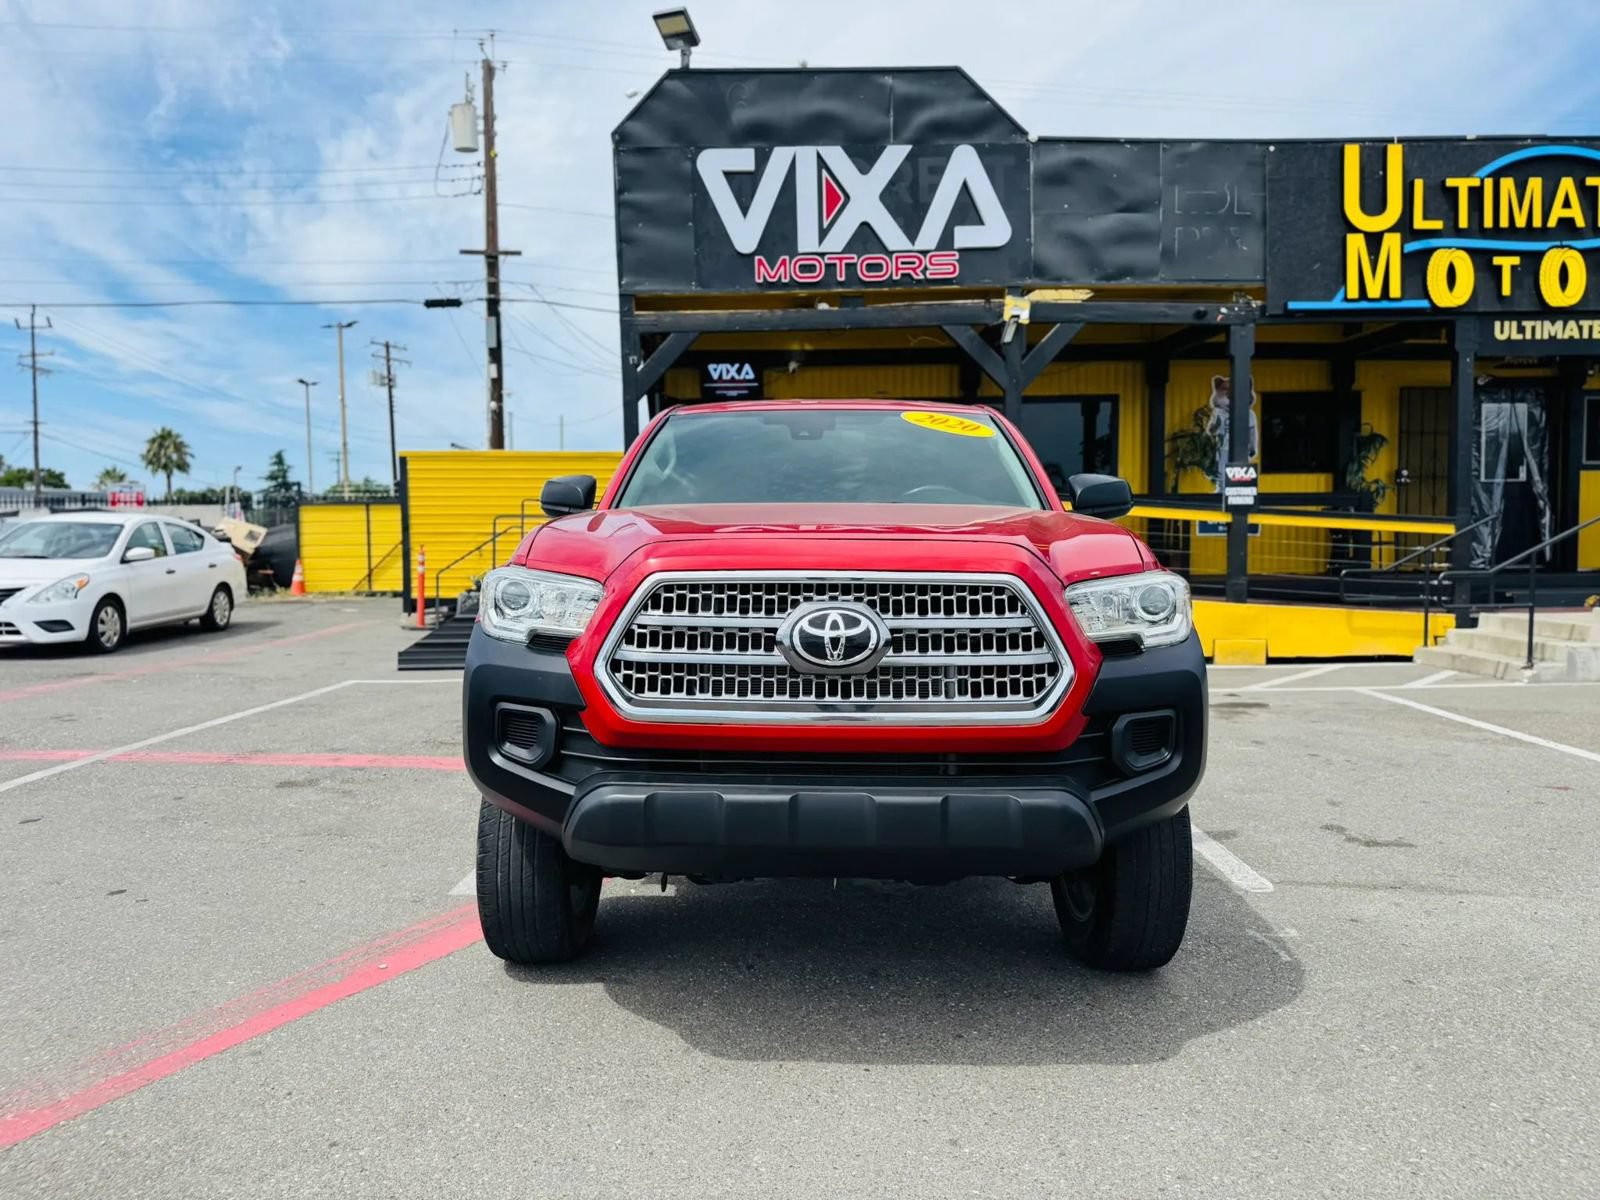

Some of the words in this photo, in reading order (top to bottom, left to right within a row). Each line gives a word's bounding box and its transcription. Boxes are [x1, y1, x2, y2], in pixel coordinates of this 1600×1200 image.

[696, 143, 1013, 254] VIXA
[754, 251, 960, 283] MOTORS
[1494, 320, 1600, 340] ULTIMATE
[707, 363, 755, 380] VIXA
[913, 413, 981, 432] 2020
[1225, 467, 1257, 478] VIXA
